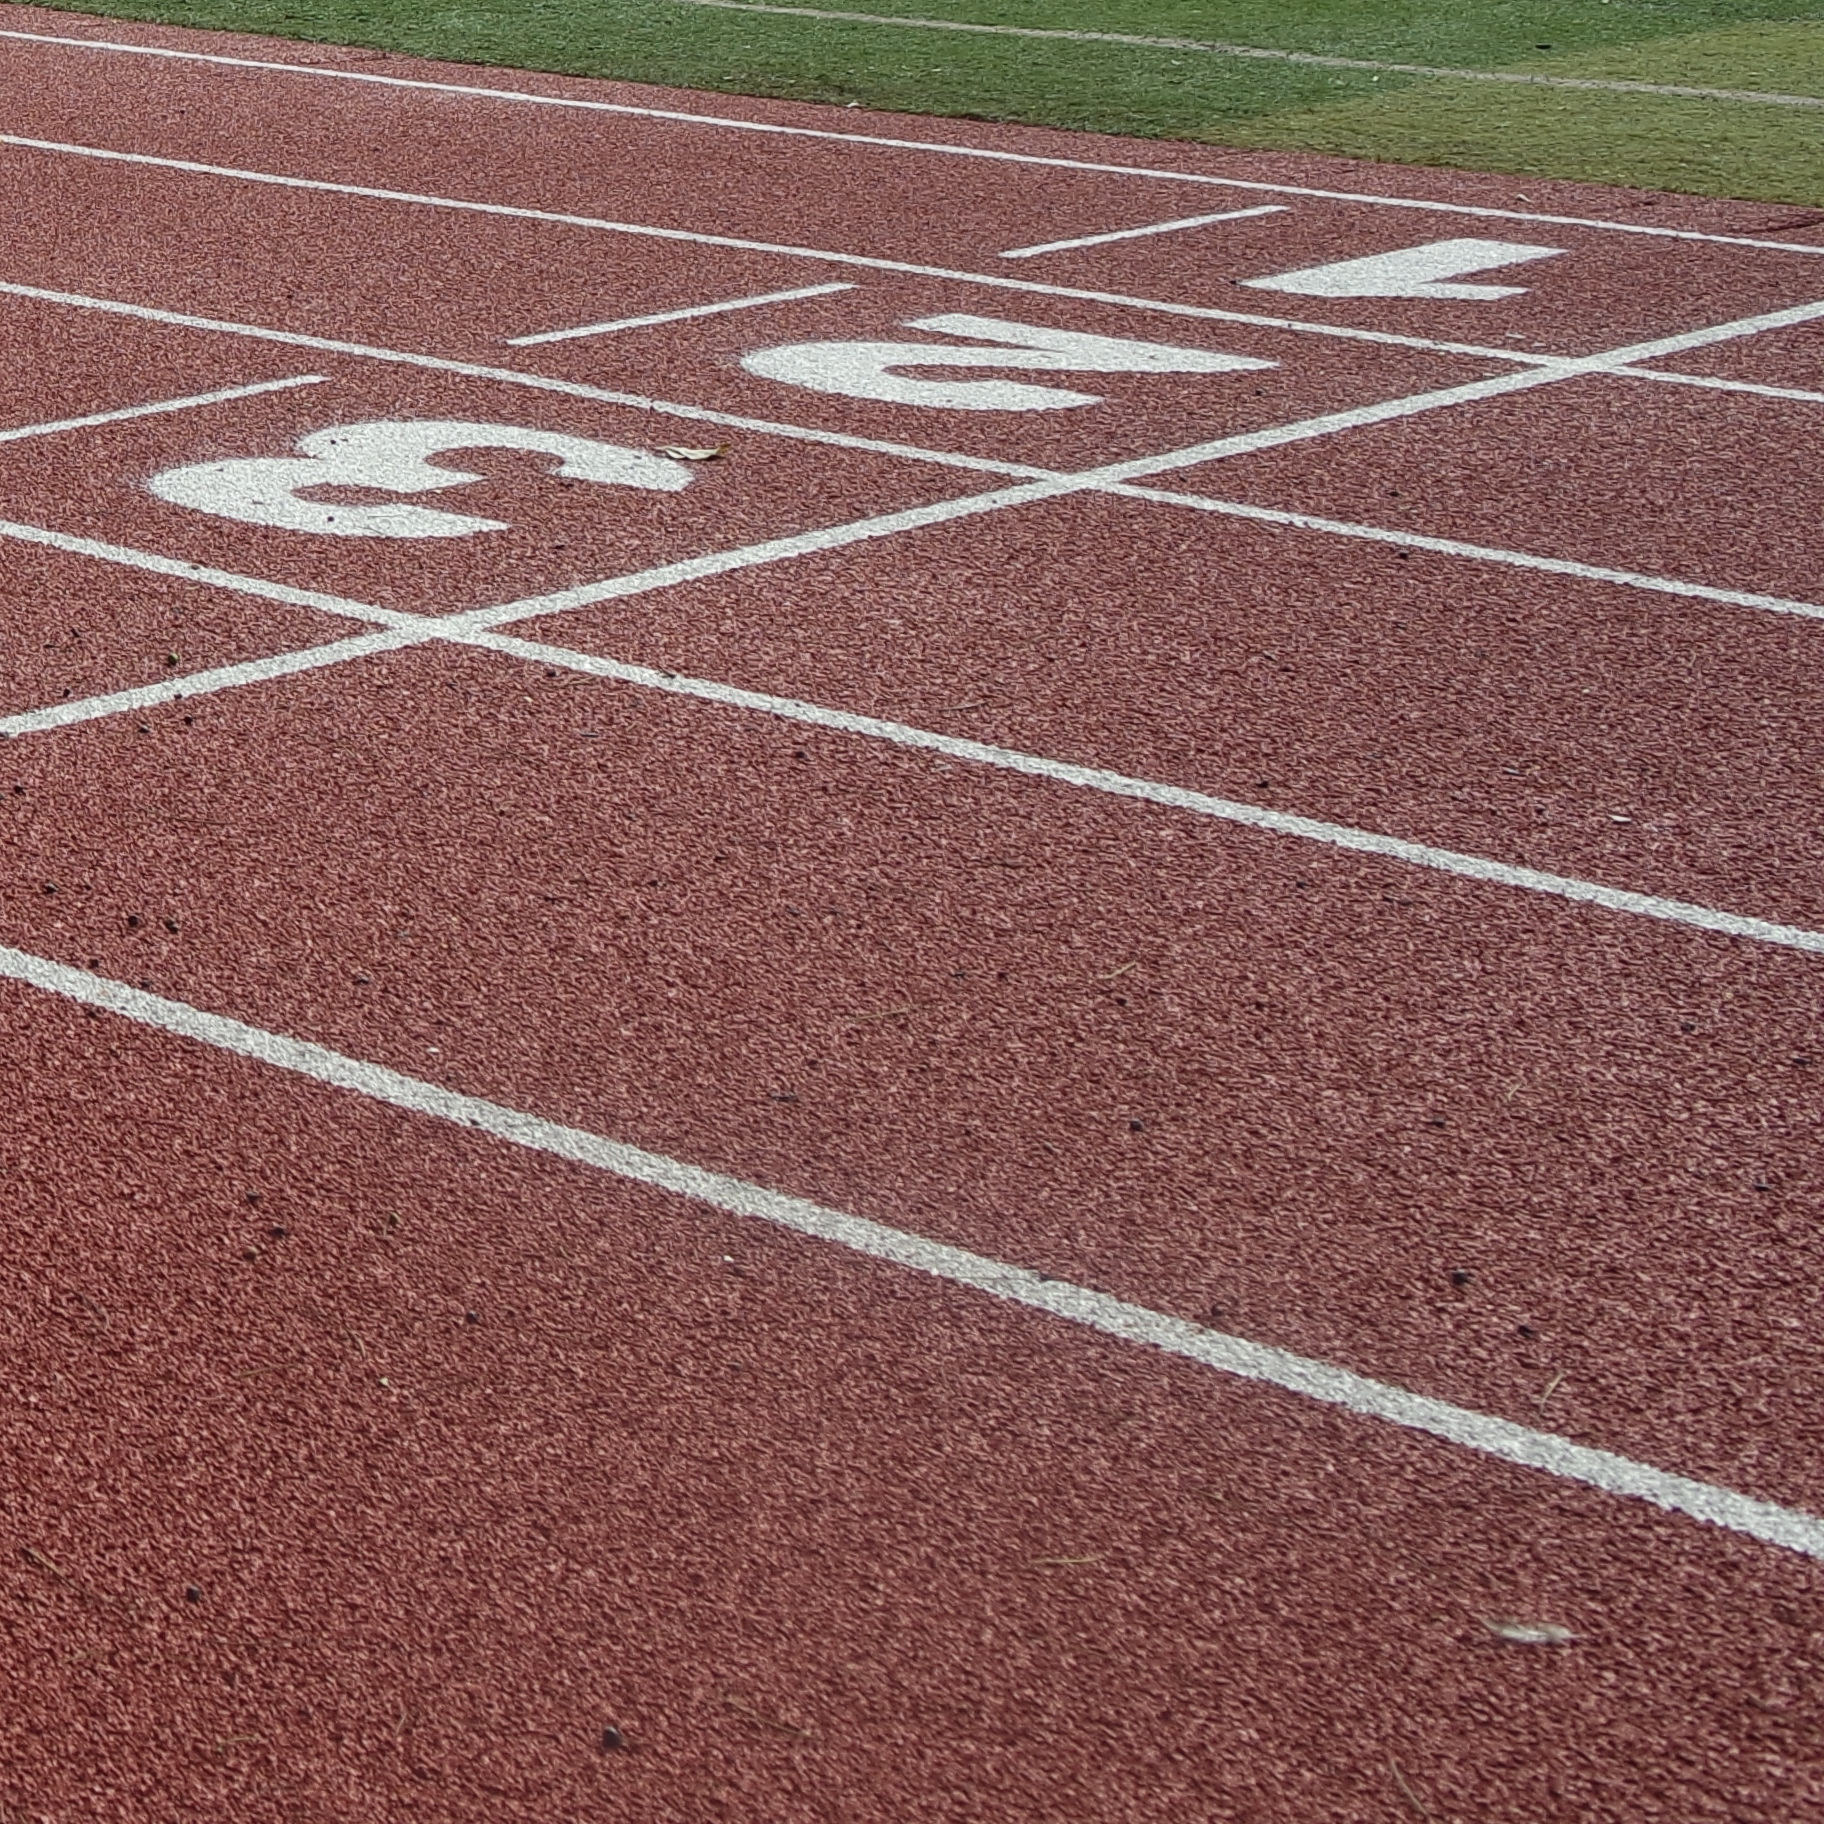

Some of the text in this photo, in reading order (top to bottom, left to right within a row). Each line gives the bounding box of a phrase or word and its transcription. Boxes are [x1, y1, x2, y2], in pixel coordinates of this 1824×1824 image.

[1235, 238, 1567, 302] 1
[739, 313, 1280, 412] 2
[149, 419, 695, 540] 3
